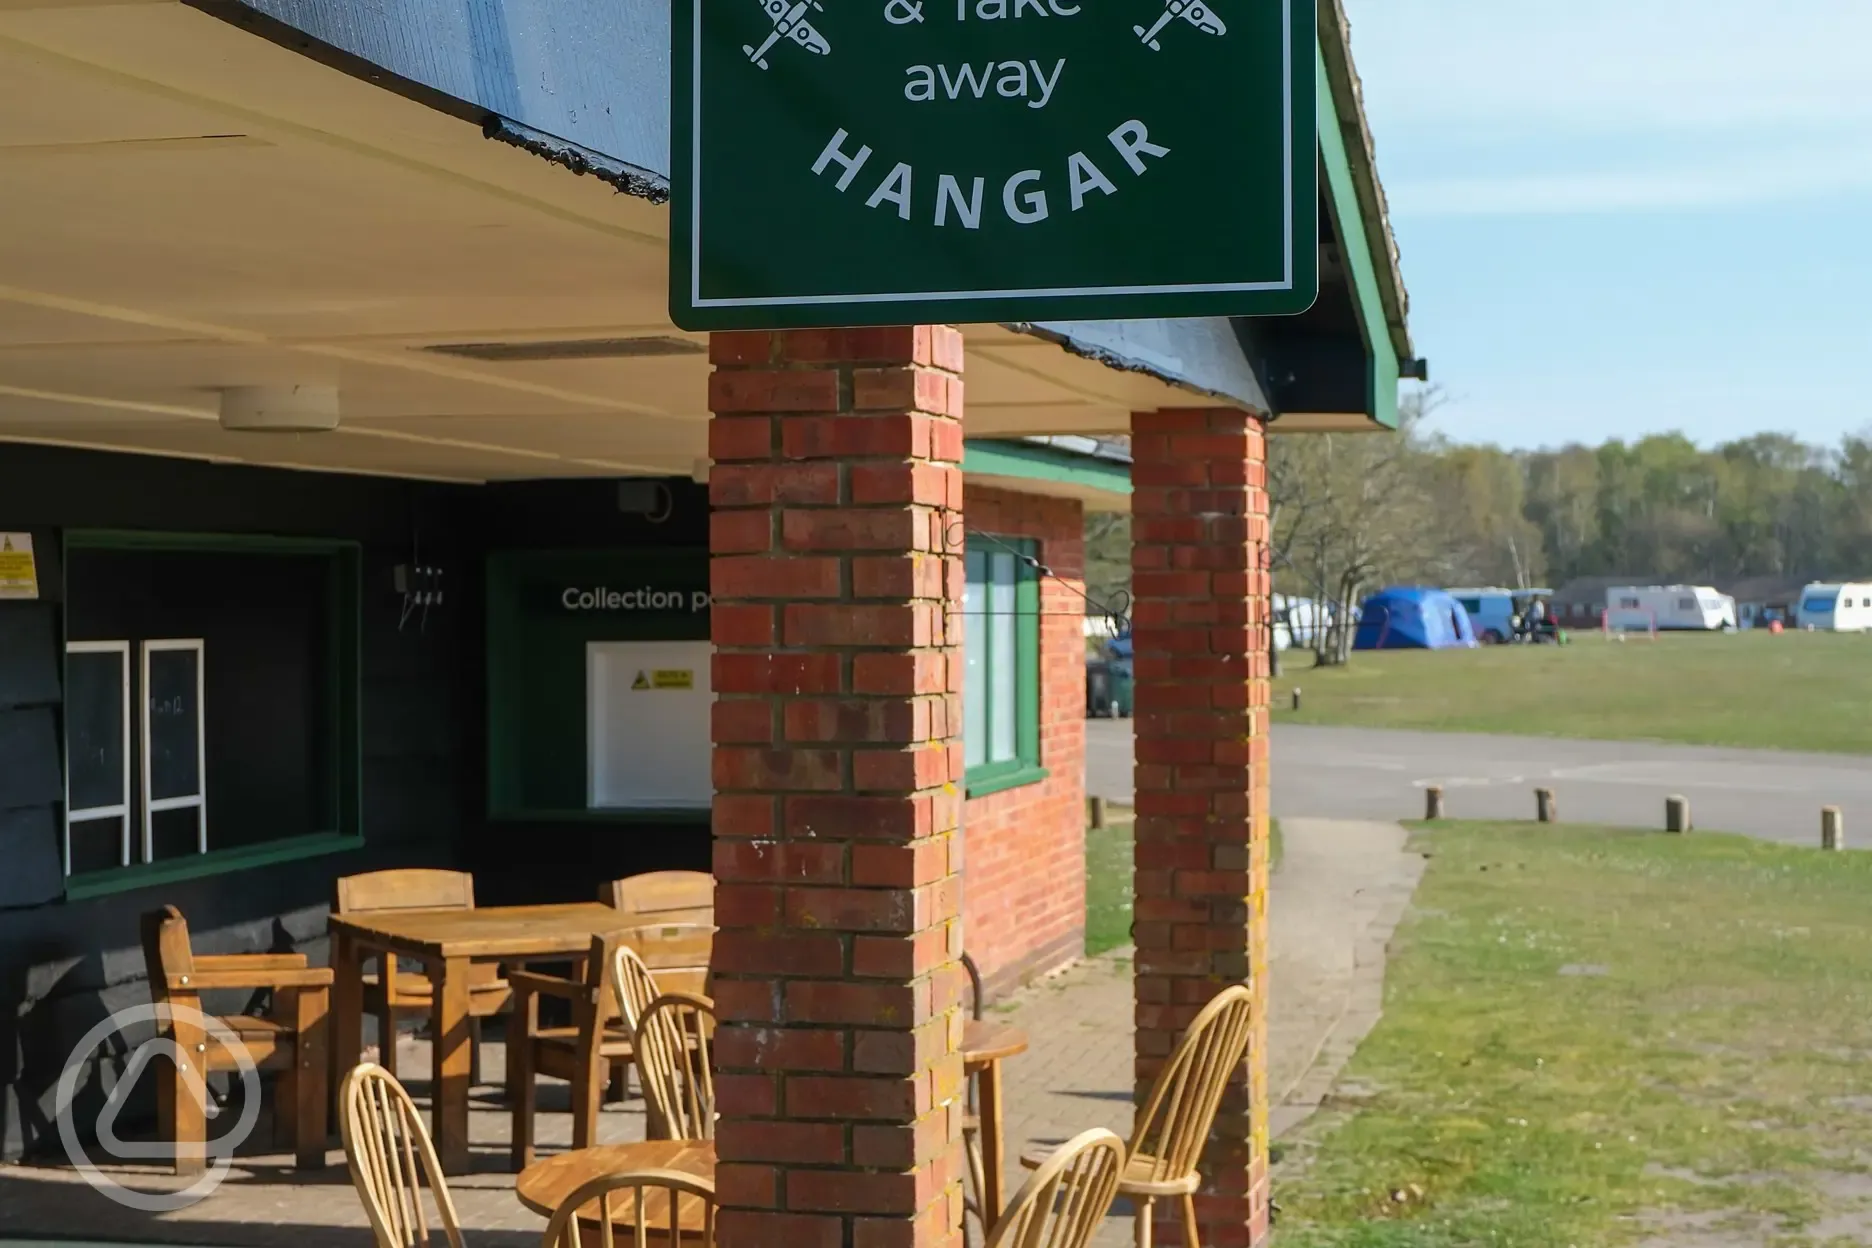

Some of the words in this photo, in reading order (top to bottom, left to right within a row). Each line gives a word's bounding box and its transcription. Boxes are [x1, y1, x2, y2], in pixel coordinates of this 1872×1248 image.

[904, 58, 1066, 108] away
[811, 119, 1171, 229] HANGAR
[562, 585, 684, 610] Collection
[691, 590, 711, 613] p
